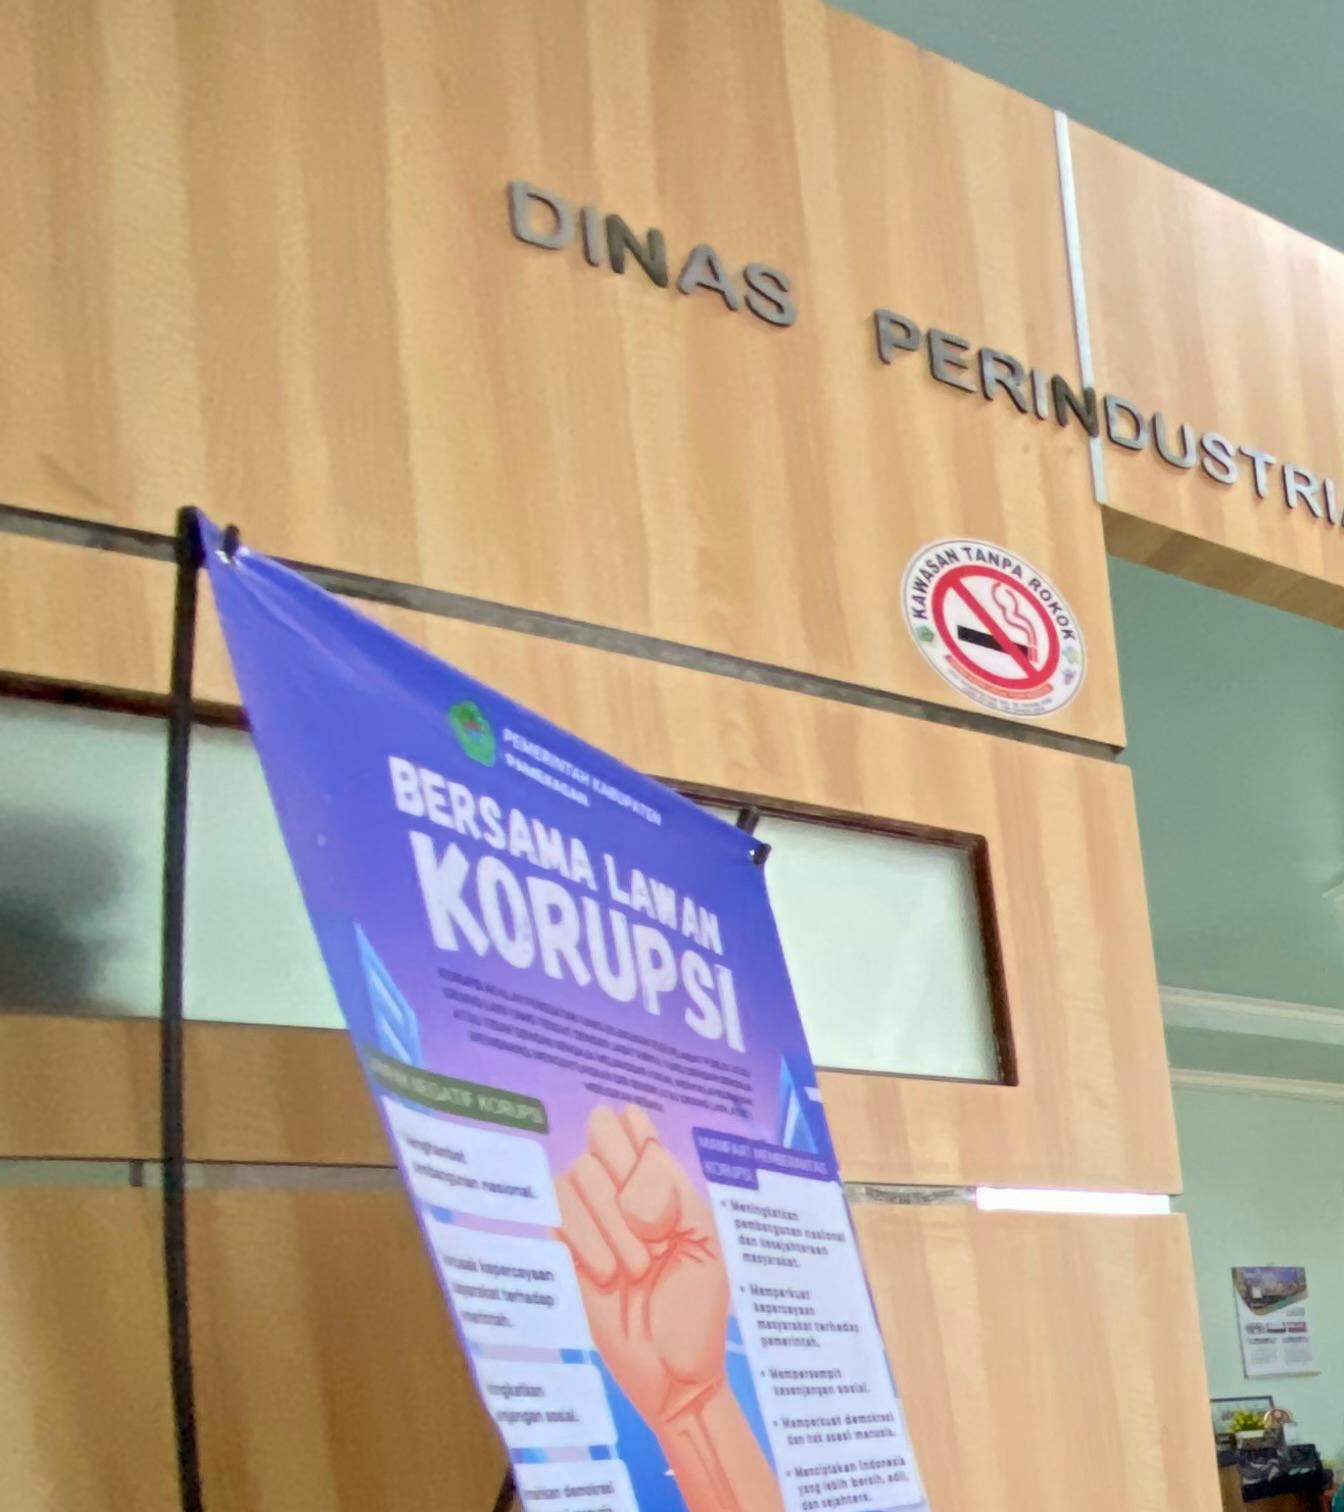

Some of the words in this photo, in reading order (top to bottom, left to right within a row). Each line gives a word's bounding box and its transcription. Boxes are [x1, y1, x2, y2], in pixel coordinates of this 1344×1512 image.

[507, 181, 797, 327] DINAS
[911, 548, 960, 620] KAWASAN
[962, 547, 1023, 578] TANPA
[1028, 578, 1076, 641] ROKOK
[388, 755, 597, 891] BERSAMA
[603, 853, 723, 956] LAWAN
[409, 831, 746, 1053] KORUPSI
